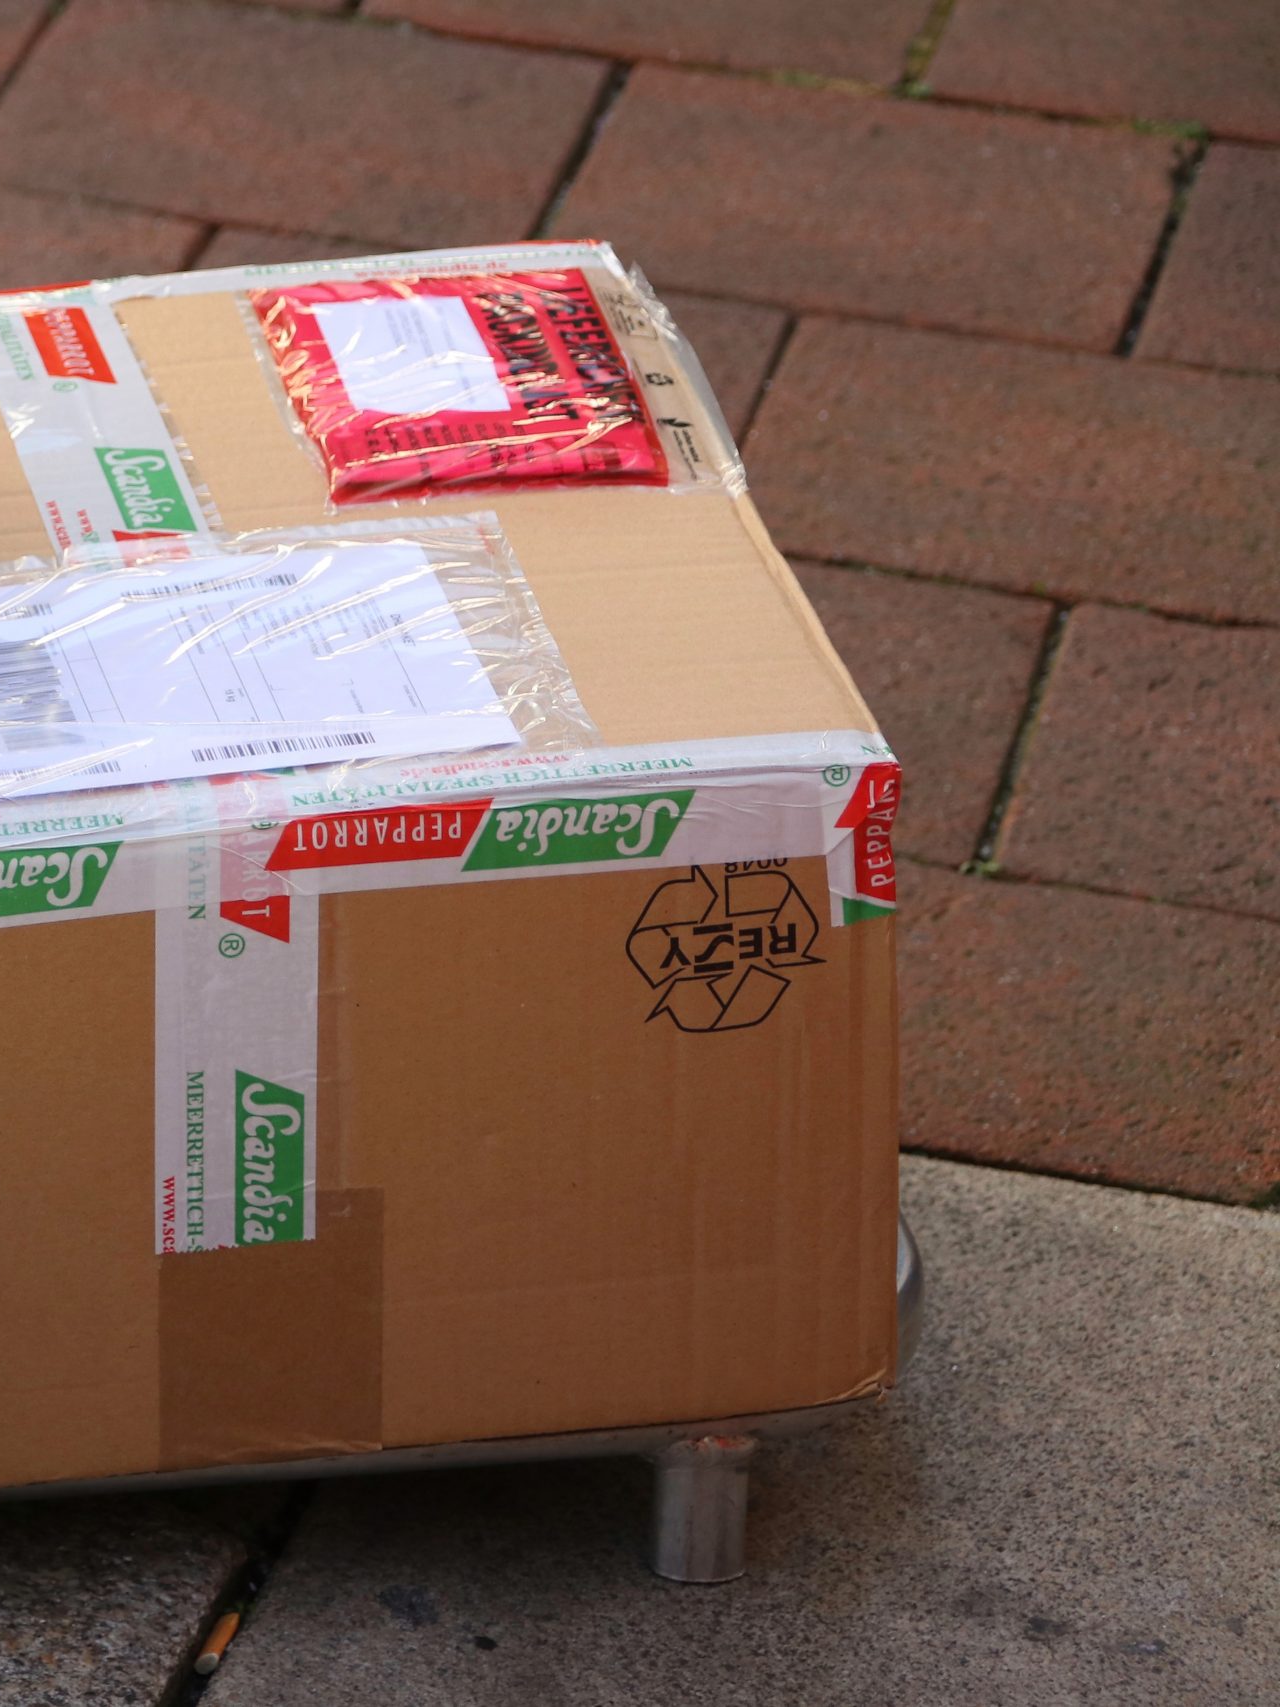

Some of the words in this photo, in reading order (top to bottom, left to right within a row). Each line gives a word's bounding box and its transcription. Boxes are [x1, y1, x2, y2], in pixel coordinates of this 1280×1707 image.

[105, 450, 175, 527] Scandia
[294, 811, 461, 852] PEPPARROT
[497, 798, 679, 858] Scandia
[660, 922, 798, 974] RESY
[242, 1082, 302, 1245] Scandia
